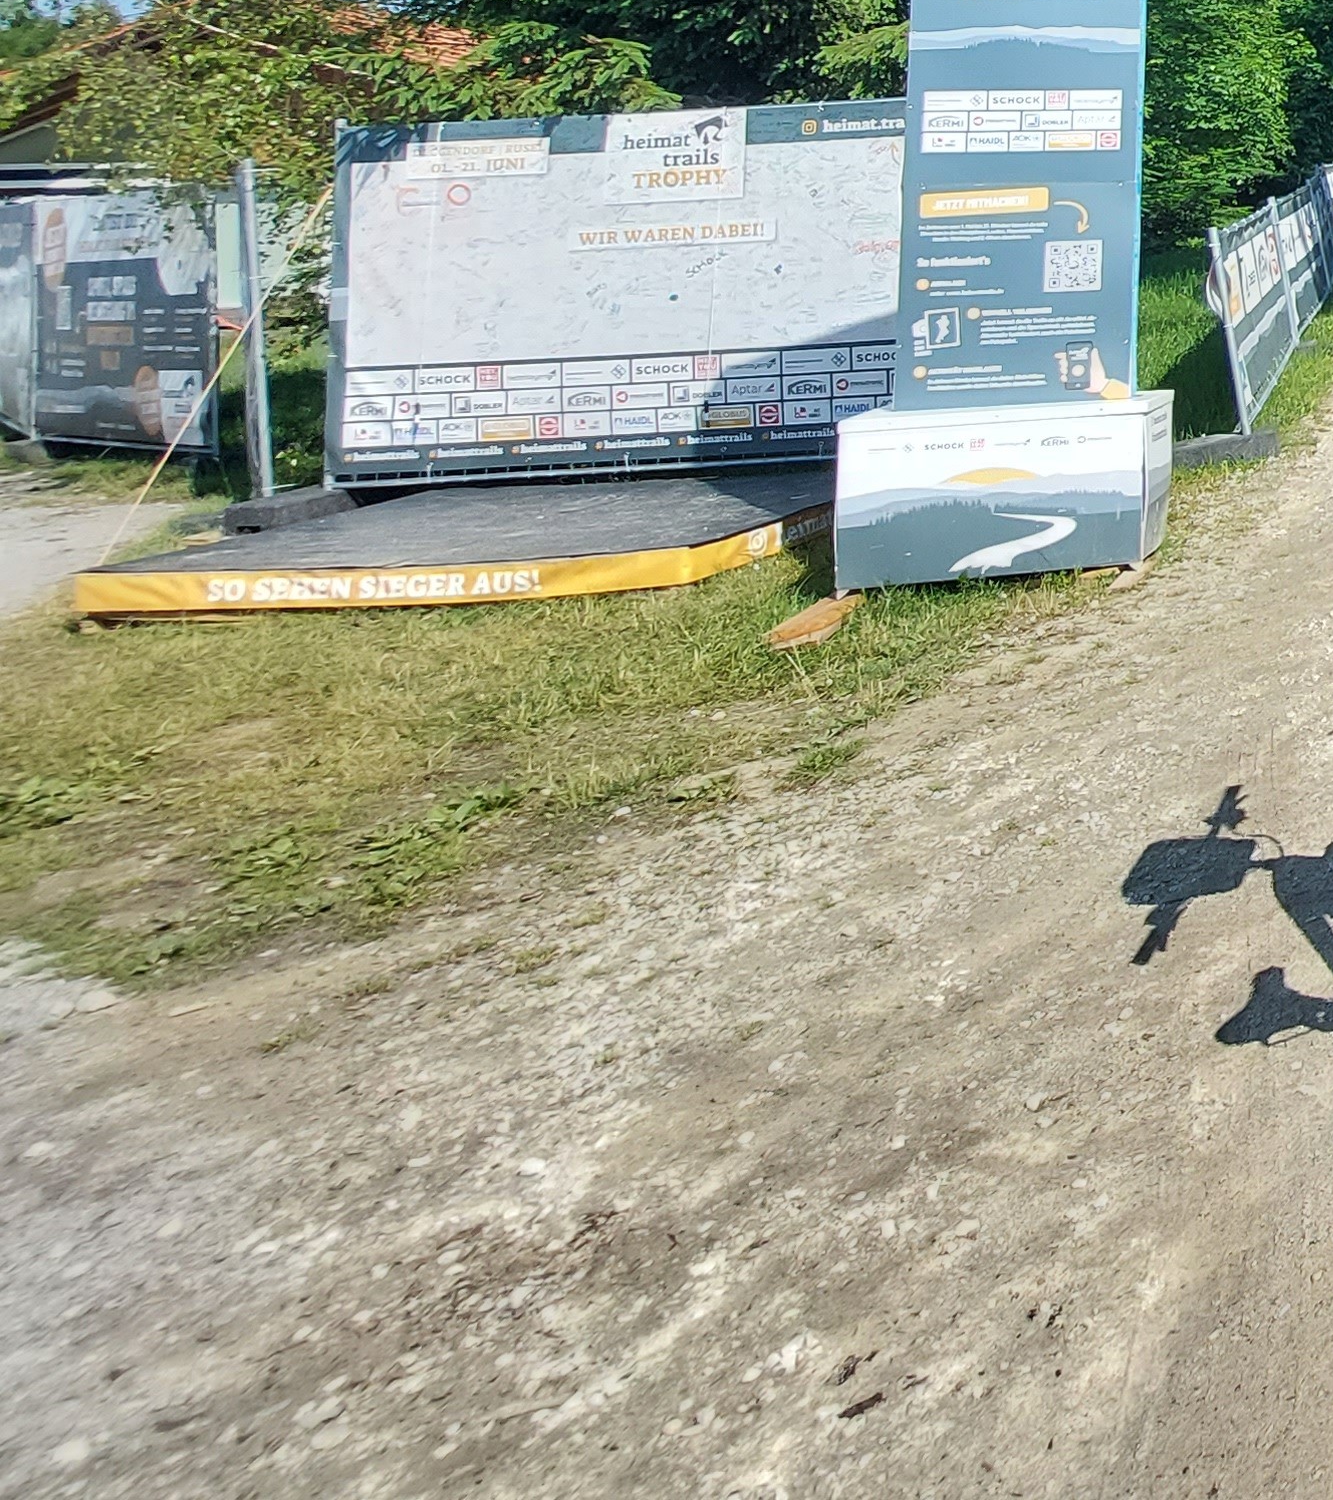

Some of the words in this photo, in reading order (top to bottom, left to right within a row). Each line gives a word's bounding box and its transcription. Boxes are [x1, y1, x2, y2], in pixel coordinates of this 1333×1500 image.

[993, 96, 1040, 104] SCHOCK
[822, 118, 906, 133] heimat.tra
[622, 133, 691, 150] heimat
[663, 149, 720, 167] trails
[632, 168, 727, 189] TROPHY
[579, 231, 618, 245] WIR
[624, 227, 695, 244] WAREN
[700, 223, 765, 240] DABEI!
[856, 352, 896, 363] SCHOC
[636, 363, 689, 375] SCHOCK
[420, 374, 471, 386] SCHOCK
[787, 380, 827, 395] KERMI
[732, 384, 763, 396] Aptar
[924, 442, 965, 450] SCHOCK
[207, 578, 246, 602] SO
[358, 574, 467, 600] SIEGER
[471, 569, 544, 596] AUS!
